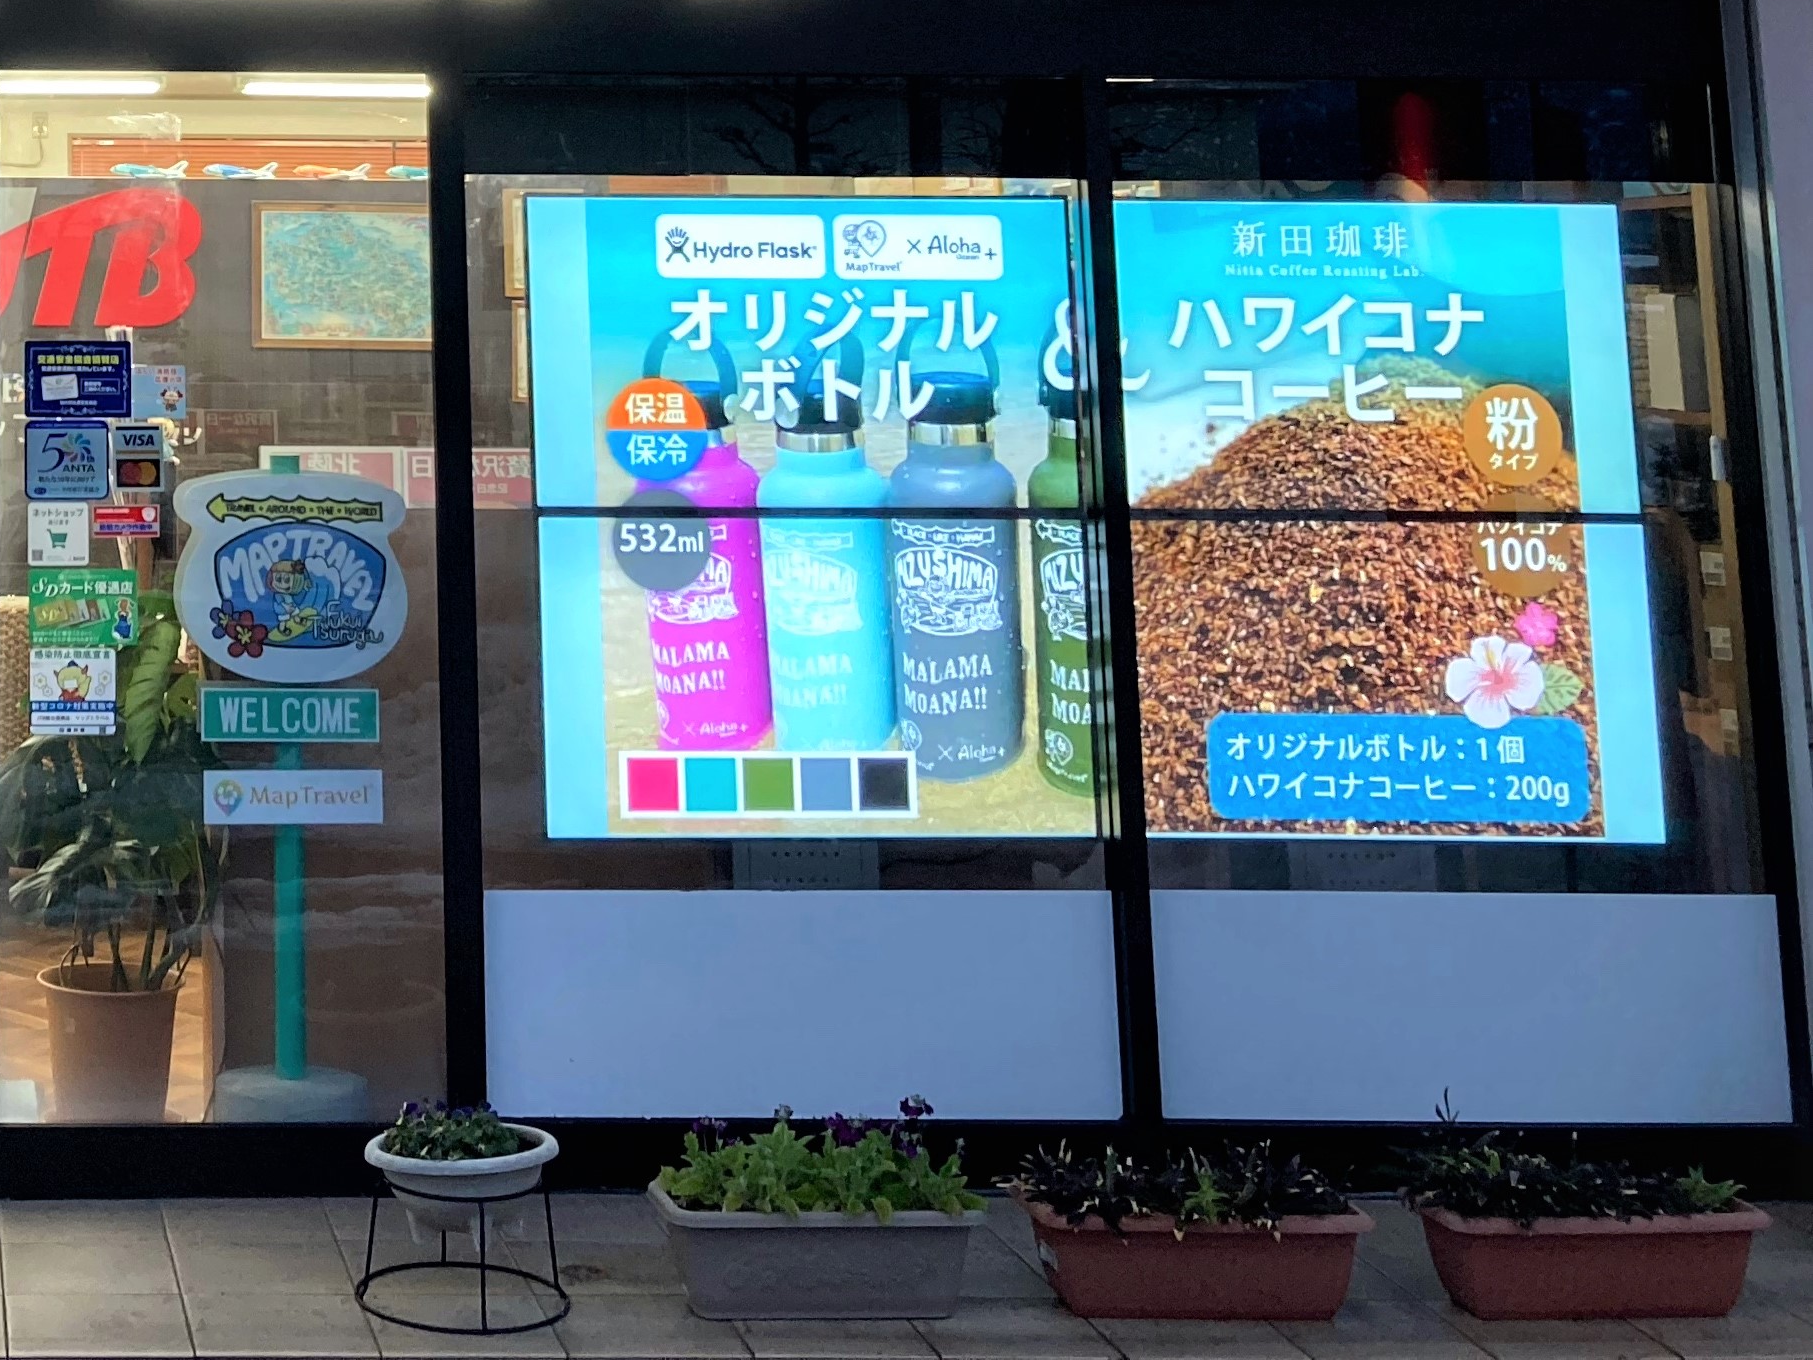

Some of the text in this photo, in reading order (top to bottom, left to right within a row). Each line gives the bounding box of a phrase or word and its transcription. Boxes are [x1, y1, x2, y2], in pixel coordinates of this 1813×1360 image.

[694, 242, 753, 263] Hydro
[927, 235, 981, 254] Aloha
[1232, 220, 1409, 258] 新田珈琲
[1269, 264, 1317, 276] Coffee
[1323, 264, 1388, 280] Roasting
[669, 287, 999, 353] オリジナル
[1168, 292, 1485, 357] ハワイコナ
[739, 356, 936, 423] ボトル
[1204, 364, 1463, 423] コーヒー
[624, 392, 687, 425] 保温
[1486, 397, 1538, 452] 粉
[123, 434, 155, 447] VISA
[626, 434, 688, 465] 保冷
[62, 464, 96, 473] ANTA
[1489, 453, 1539, 471] タイプ
[33, 508, 84, 518] ネットショップ
[266, 506, 306, 514] AROUND
[344, 507, 377, 516] WORLD
[619, 523, 704, 553] 532ml
[1480, 537, 1567, 572] 100%
[32, 577, 134, 598] SDカード優遇店
[324, 601, 365, 629] Fukui
[902, 652, 993, 684] MALAMA
[904, 683, 987, 715] MOANA!!
[219, 696, 361, 733] WELCOME
[249, 785, 368, 807] MapTravel
